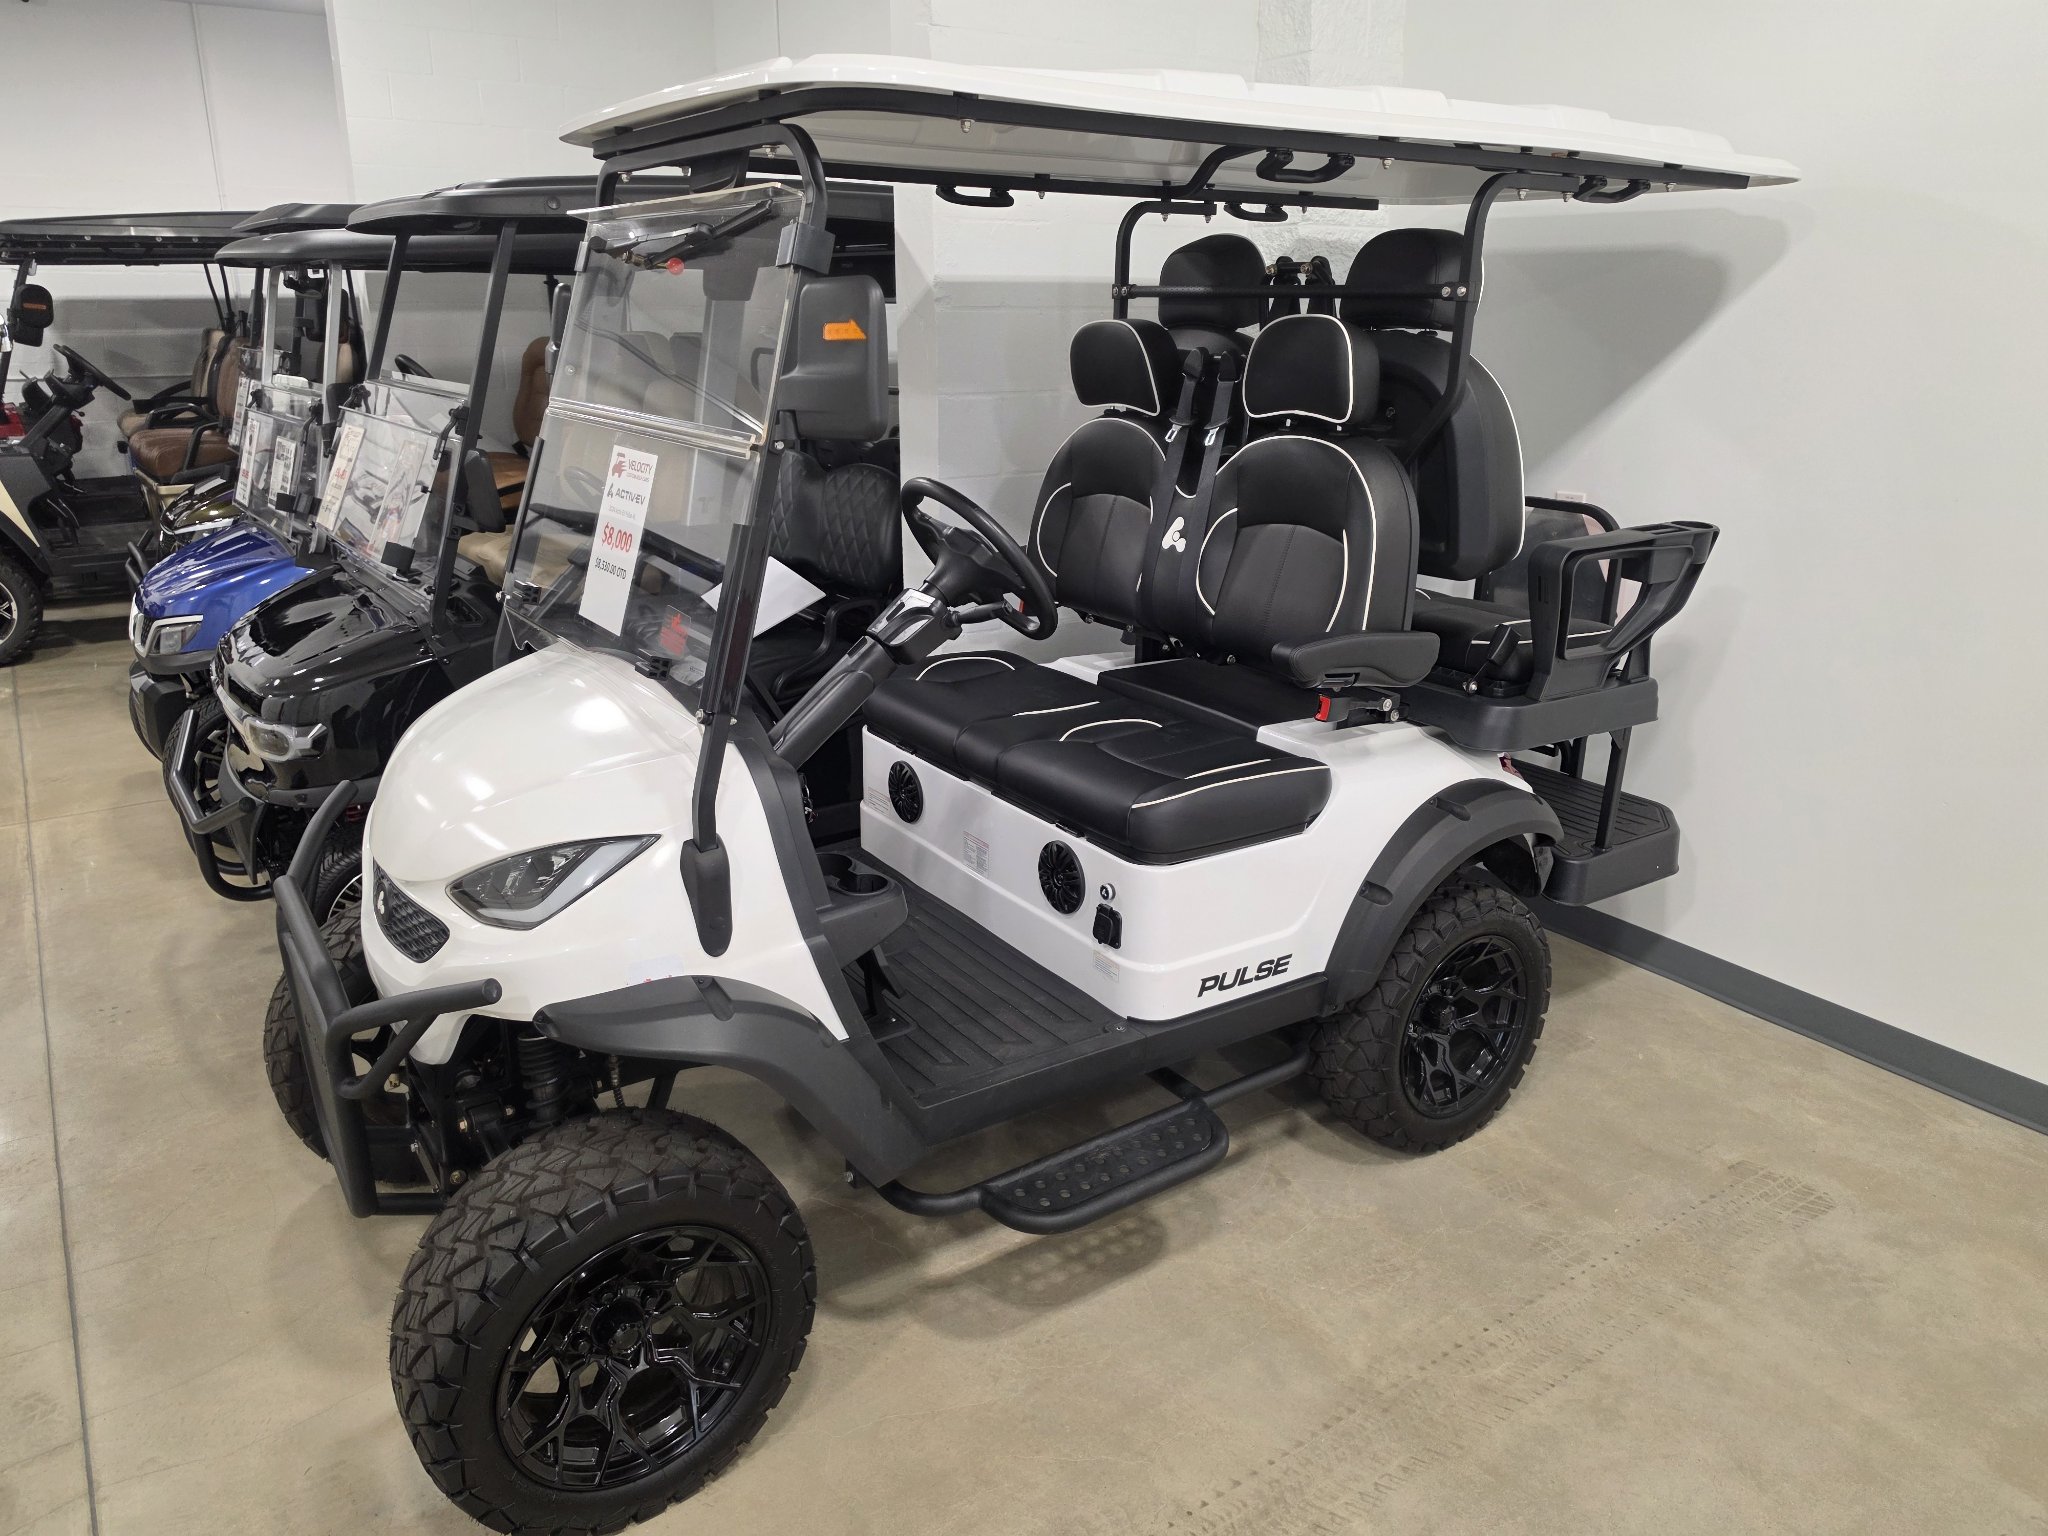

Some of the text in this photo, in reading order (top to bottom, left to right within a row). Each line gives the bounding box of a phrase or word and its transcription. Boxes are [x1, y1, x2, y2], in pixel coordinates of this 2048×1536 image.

[628, 459, 653, 474] VELOCITY
[602, 522, 632, 552] $8,000
[616, 566, 627, 580] OTD
[1197, 953, 1293, 998] PULSE
